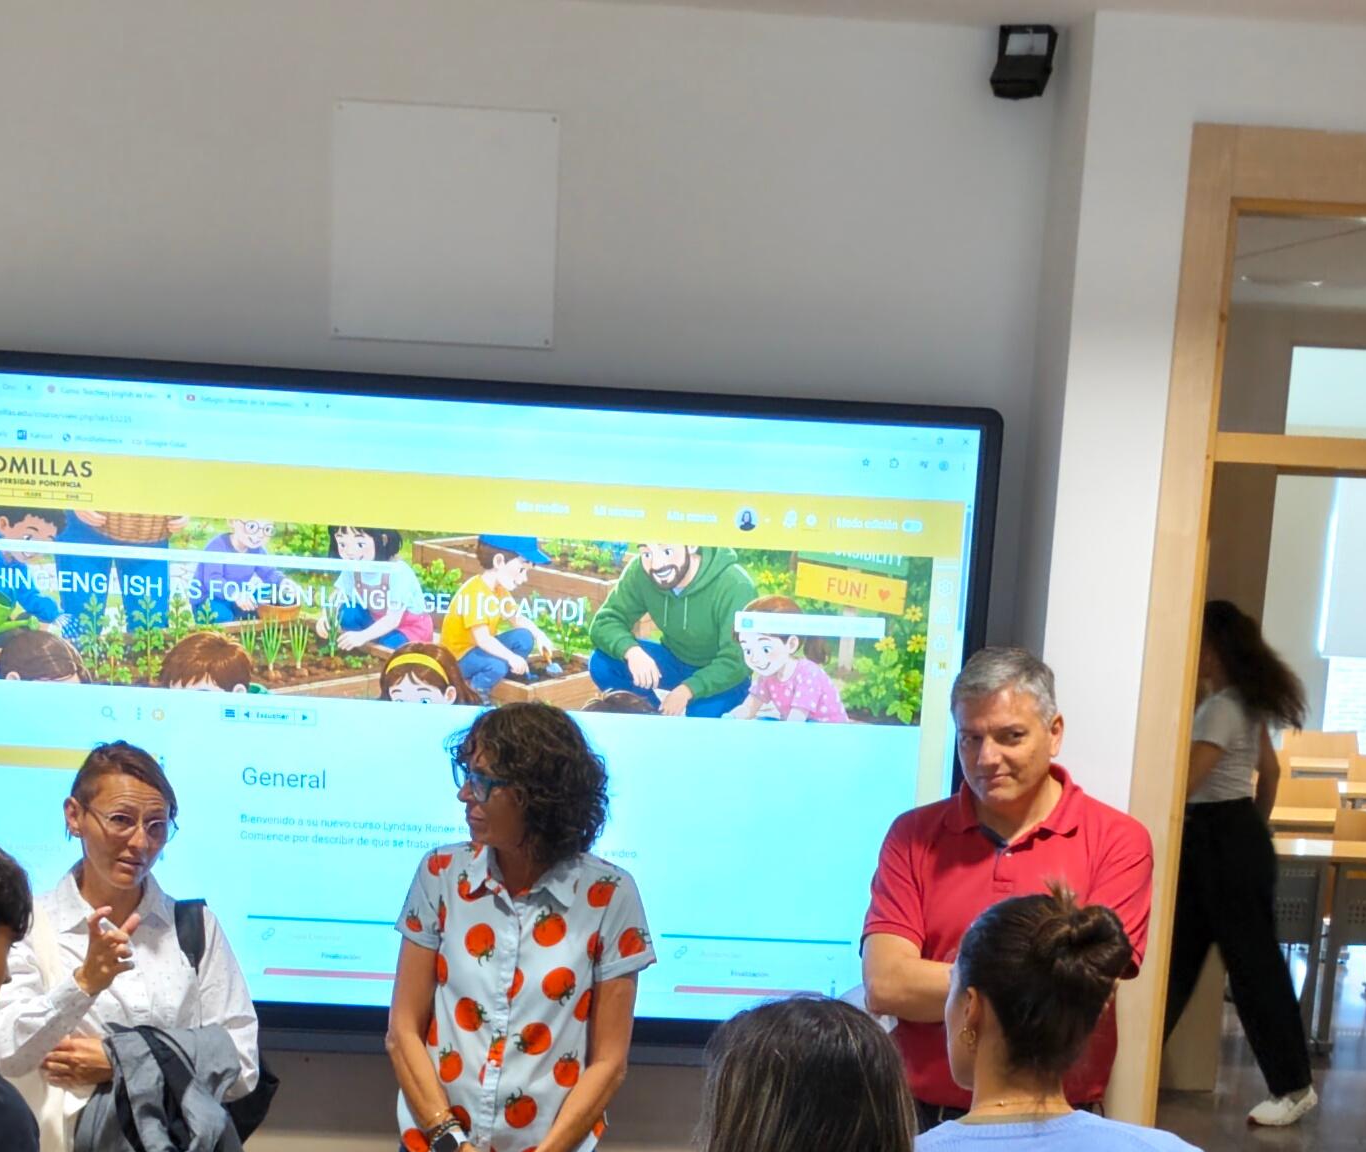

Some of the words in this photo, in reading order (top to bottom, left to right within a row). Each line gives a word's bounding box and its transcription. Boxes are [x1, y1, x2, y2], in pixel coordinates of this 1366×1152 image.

[39, 480, 82, 489] PONTIFICIA
[58, 571, 163, 600] ENGLISH
[168, 577, 203, 600] AS
[209, 580, 314, 607] FOREIGN
[320, 585, 450, 614] LANGUAGE
[457, 594, 470, 616] II
[477, 595, 585, 625] [CCAFYD]
[826, 577, 868, 600] FUN!
[242, 766, 327, 790] General
[240, 813, 295, 826] Bienvenido
[297, 817, 304, 826] a
[307, 819, 319, 827] su
[321, 819, 351, 829] nuevo
[353, 820, 382, 830] curso
[383, 820, 422, 834] Lyndsay
[240, 831, 291, 842] Comience
[292, 834, 309, 845] por
[312, 833, 355, 845] describir
[357, 835, 370, 846] de
[372, 838, 390, 849] que
[392, 839, 404, 848] se
[406, 837, 430, 849] trata
